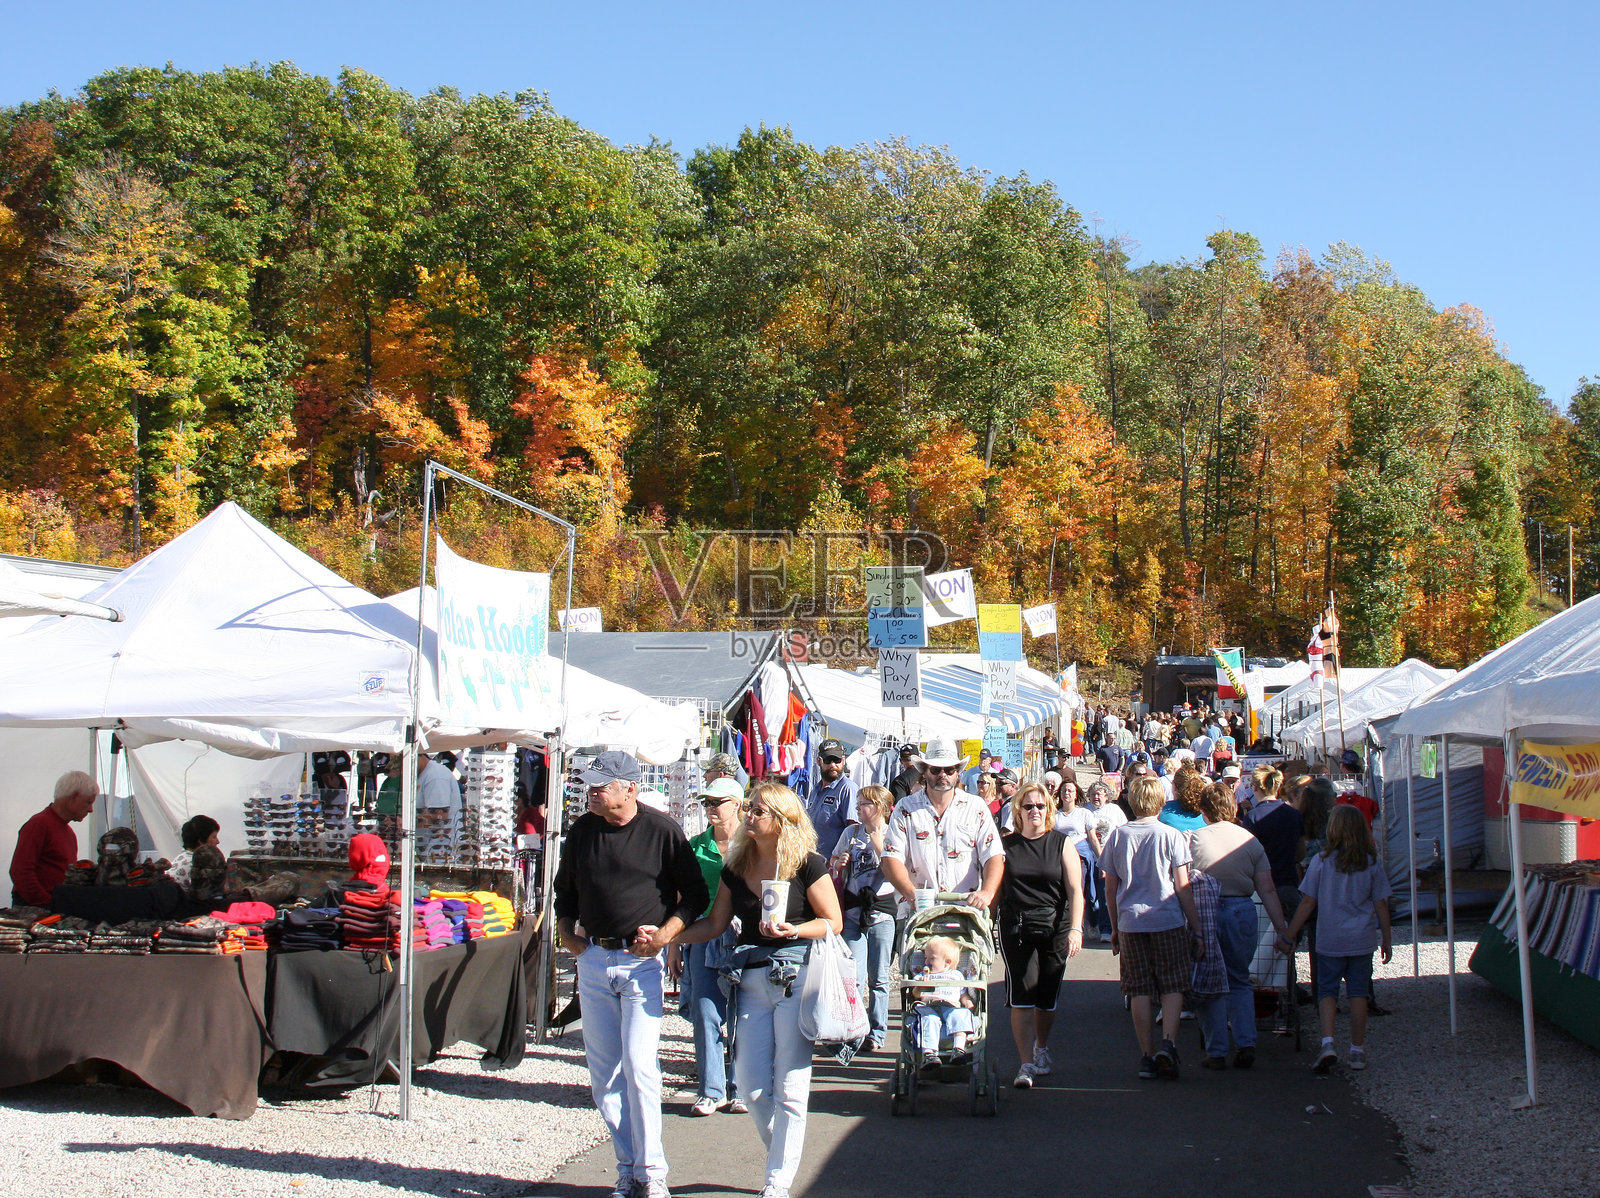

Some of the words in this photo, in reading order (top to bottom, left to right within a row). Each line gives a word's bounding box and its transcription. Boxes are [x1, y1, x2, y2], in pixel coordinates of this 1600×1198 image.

[562, 612, 598, 628] AVON
[1028, 608, 1053, 625] AVON
[477, 604, 541, 657] Hood
[874, 634, 882, 646] 6
[880, 650, 912, 668] Why
[883, 666, 910, 687] Pay
[988, 662, 1011, 675] Why
[990, 674, 1010, 690] Pay
[883, 687, 919, 705] More?
[990, 690, 1016, 701] More?
